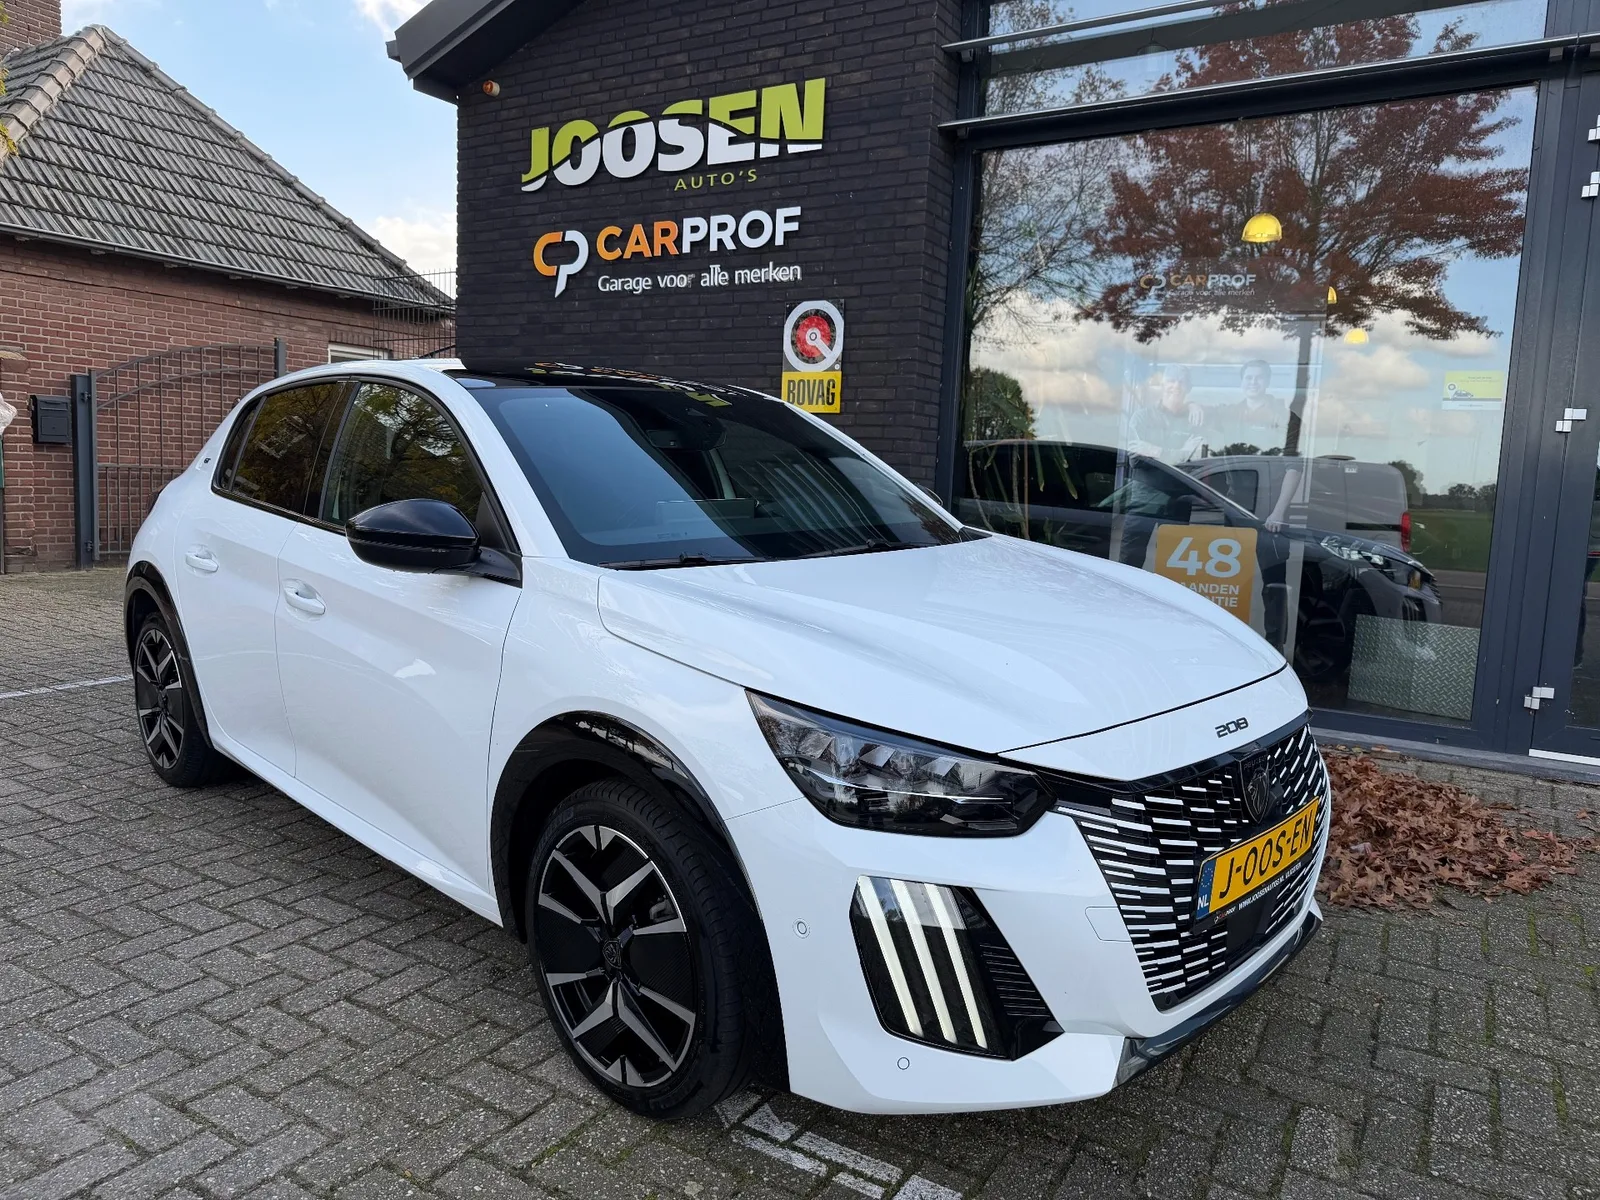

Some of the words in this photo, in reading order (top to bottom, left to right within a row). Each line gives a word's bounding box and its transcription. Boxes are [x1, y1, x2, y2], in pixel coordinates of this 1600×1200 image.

[521, 77, 826, 192] JOOSEN
[674, 169, 758, 191] AUTO'S
[596, 206, 801, 261] CARPROF
[598, 274, 652, 294] Garage
[657, 273, 696, 288] voor
[700, 264, 729, 287] alle
[734, 262, 801, 285] merken
[1170, 274, 1257, 286] CARPROF
[786, 378, 836, 406] BOVAG
[1166, 536, 1242, 578] 48
[1180, 582, 1239, 595] ANDEN
[1215, 717, 1249, 738] 208
[1219, 810, 1313, 899] J-OOS-EN
[1197, 894, 1210, 910] NL
